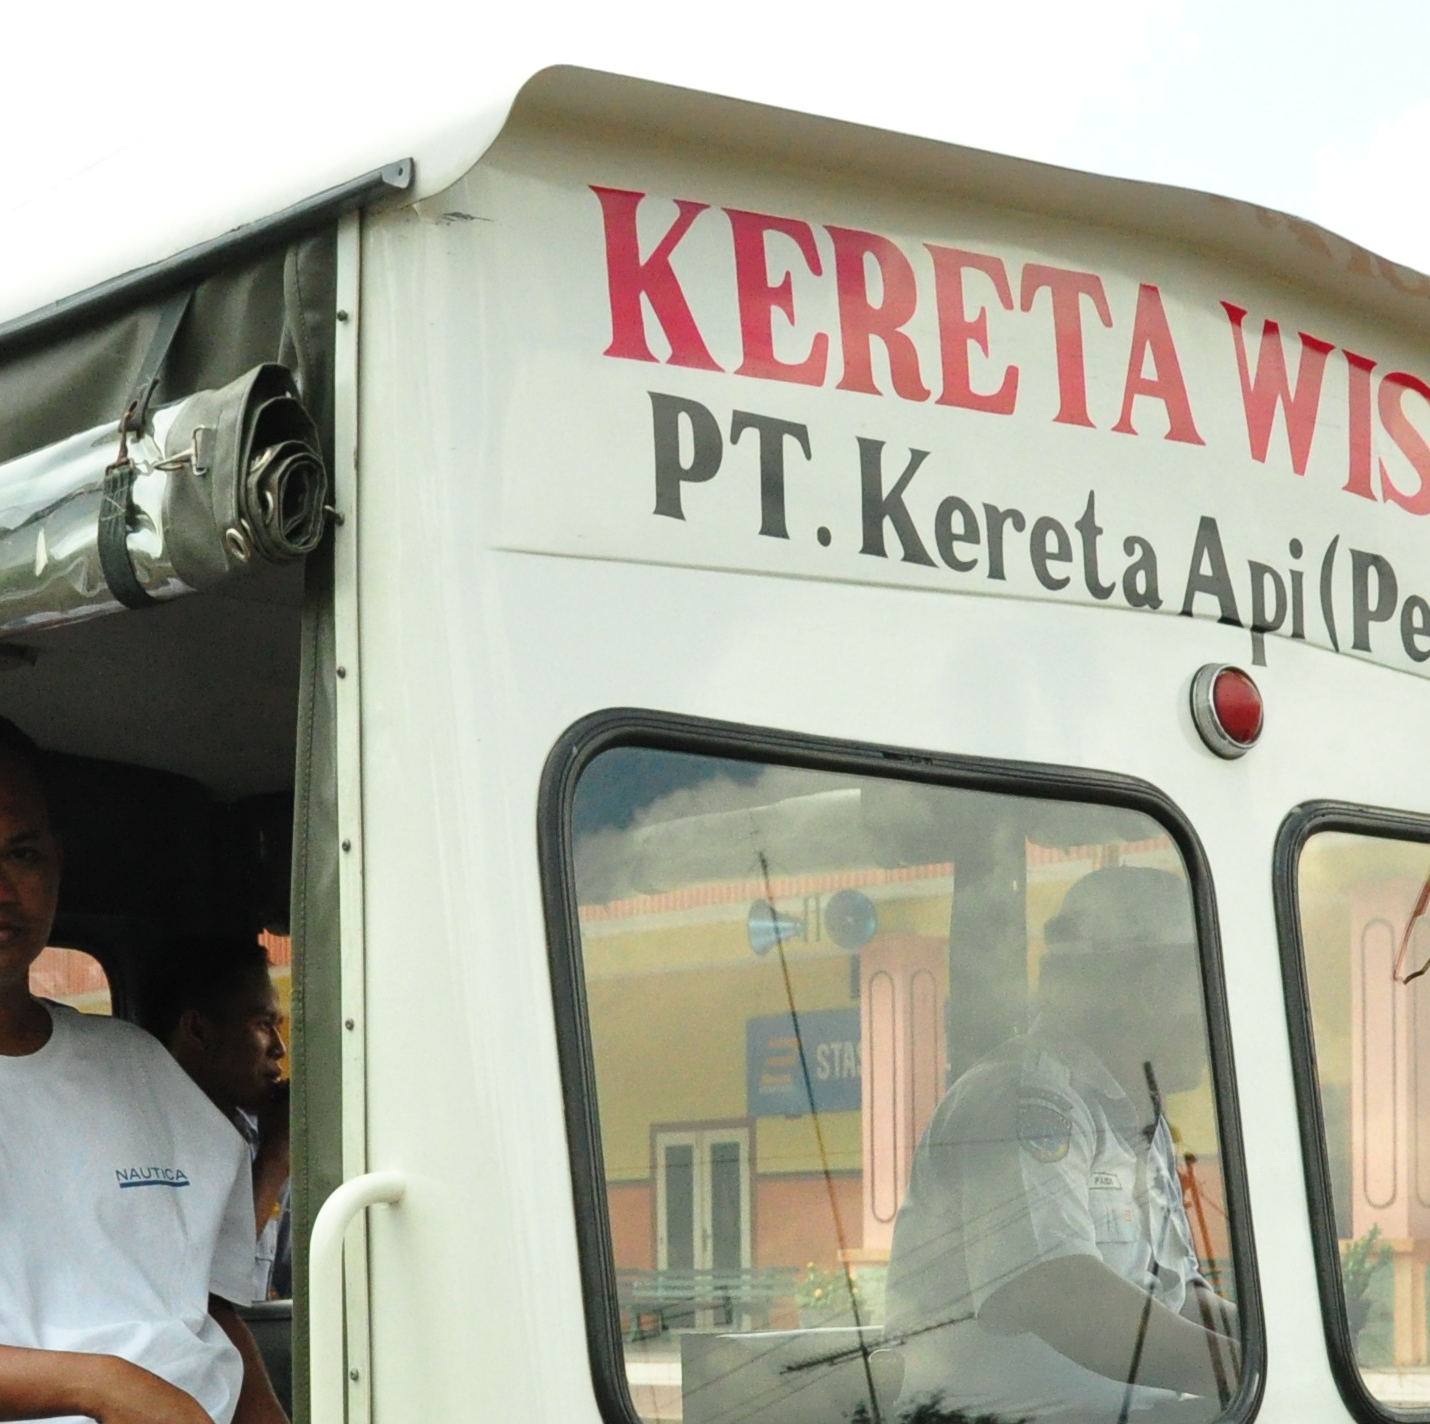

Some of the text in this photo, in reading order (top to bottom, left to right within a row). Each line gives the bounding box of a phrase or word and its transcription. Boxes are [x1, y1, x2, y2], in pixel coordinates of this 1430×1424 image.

[588, 185, 1206, 446] KERETA
[646, 390, 833, 548] PT.
[856, 436, 1164, 611] Kereta
[1179, 515, 1306, 667] Api
[816, 1040, 862, 1081] STA
[115, 1166, 189, 1182] NAUTICA
